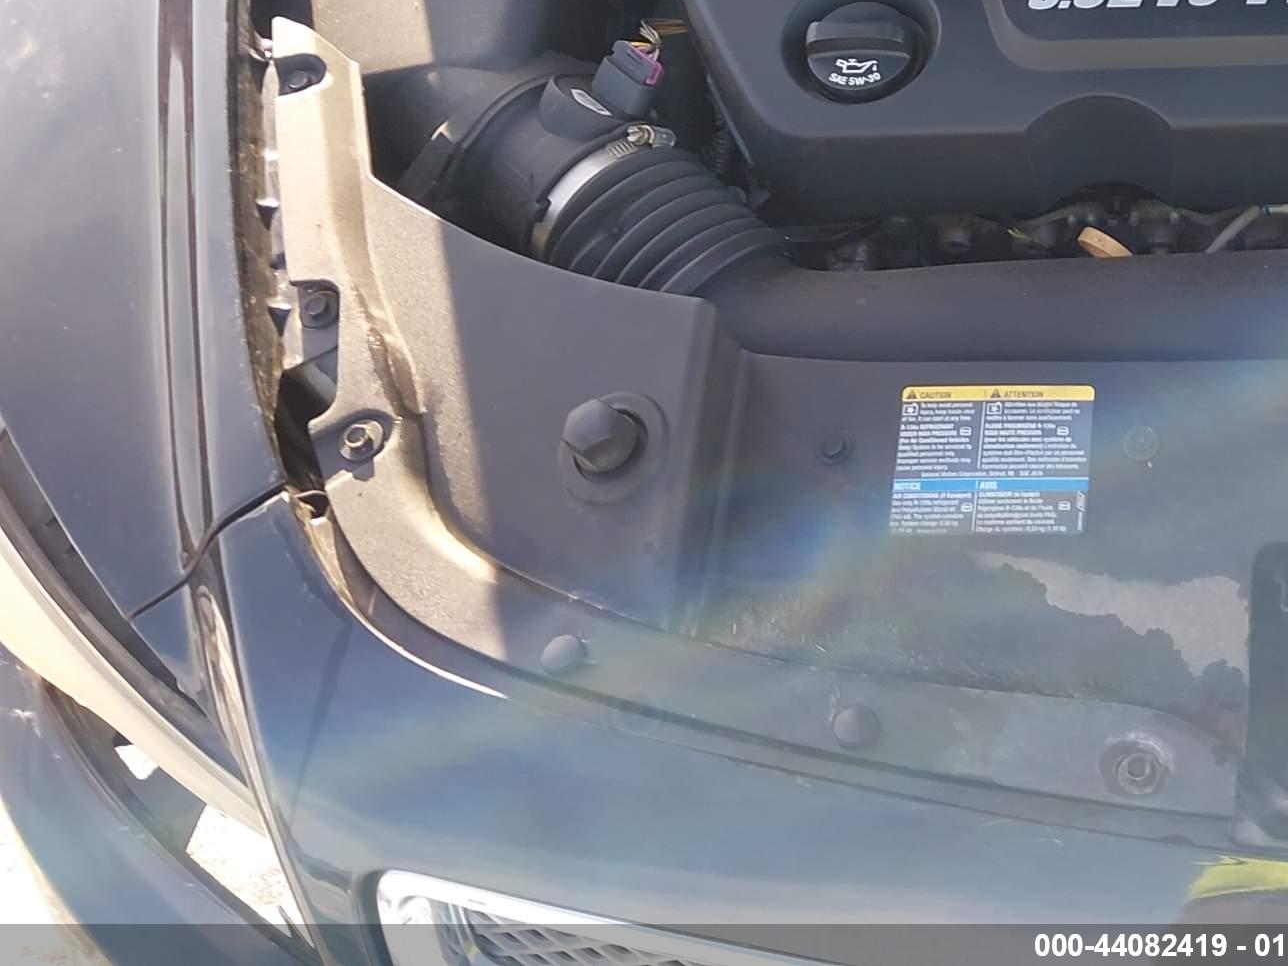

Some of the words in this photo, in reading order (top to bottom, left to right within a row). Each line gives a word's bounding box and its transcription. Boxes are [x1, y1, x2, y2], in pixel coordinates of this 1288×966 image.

[828, 73, 848, 85] SAE
[848, 72, 881, 85] 5W-30
[919, 391, 952, 399] CAUTION
[893, 481, 921, 490] NOTICE
[979, 481, 998, 490] AVIS
